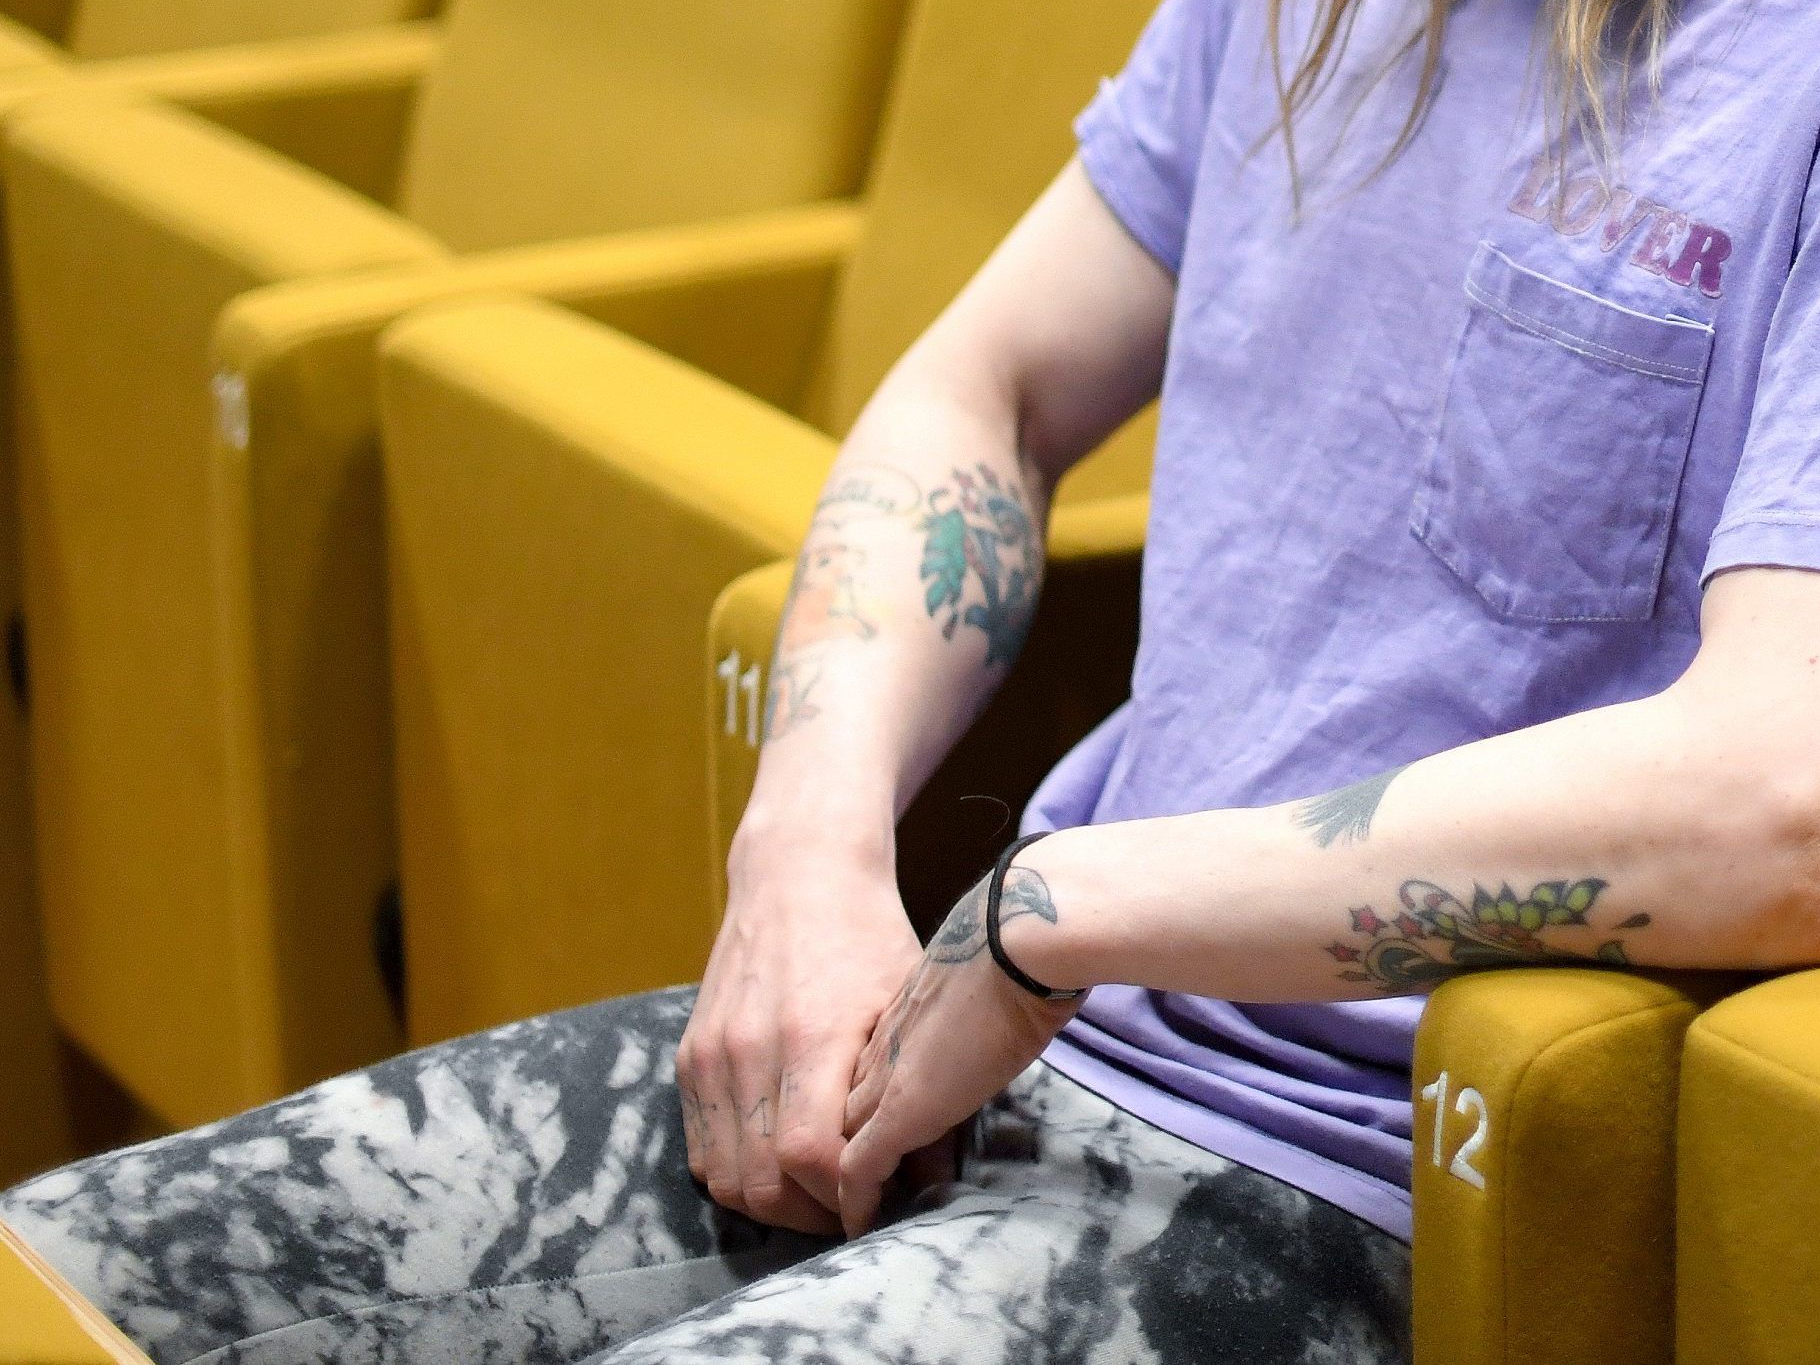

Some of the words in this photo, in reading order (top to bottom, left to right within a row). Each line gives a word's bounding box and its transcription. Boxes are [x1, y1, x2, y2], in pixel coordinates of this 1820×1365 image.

[1507, 153, 1732, 298] LOVER
[717, 647, 761, 748] 11
[1422, 1070, 1488, 1191] 12
